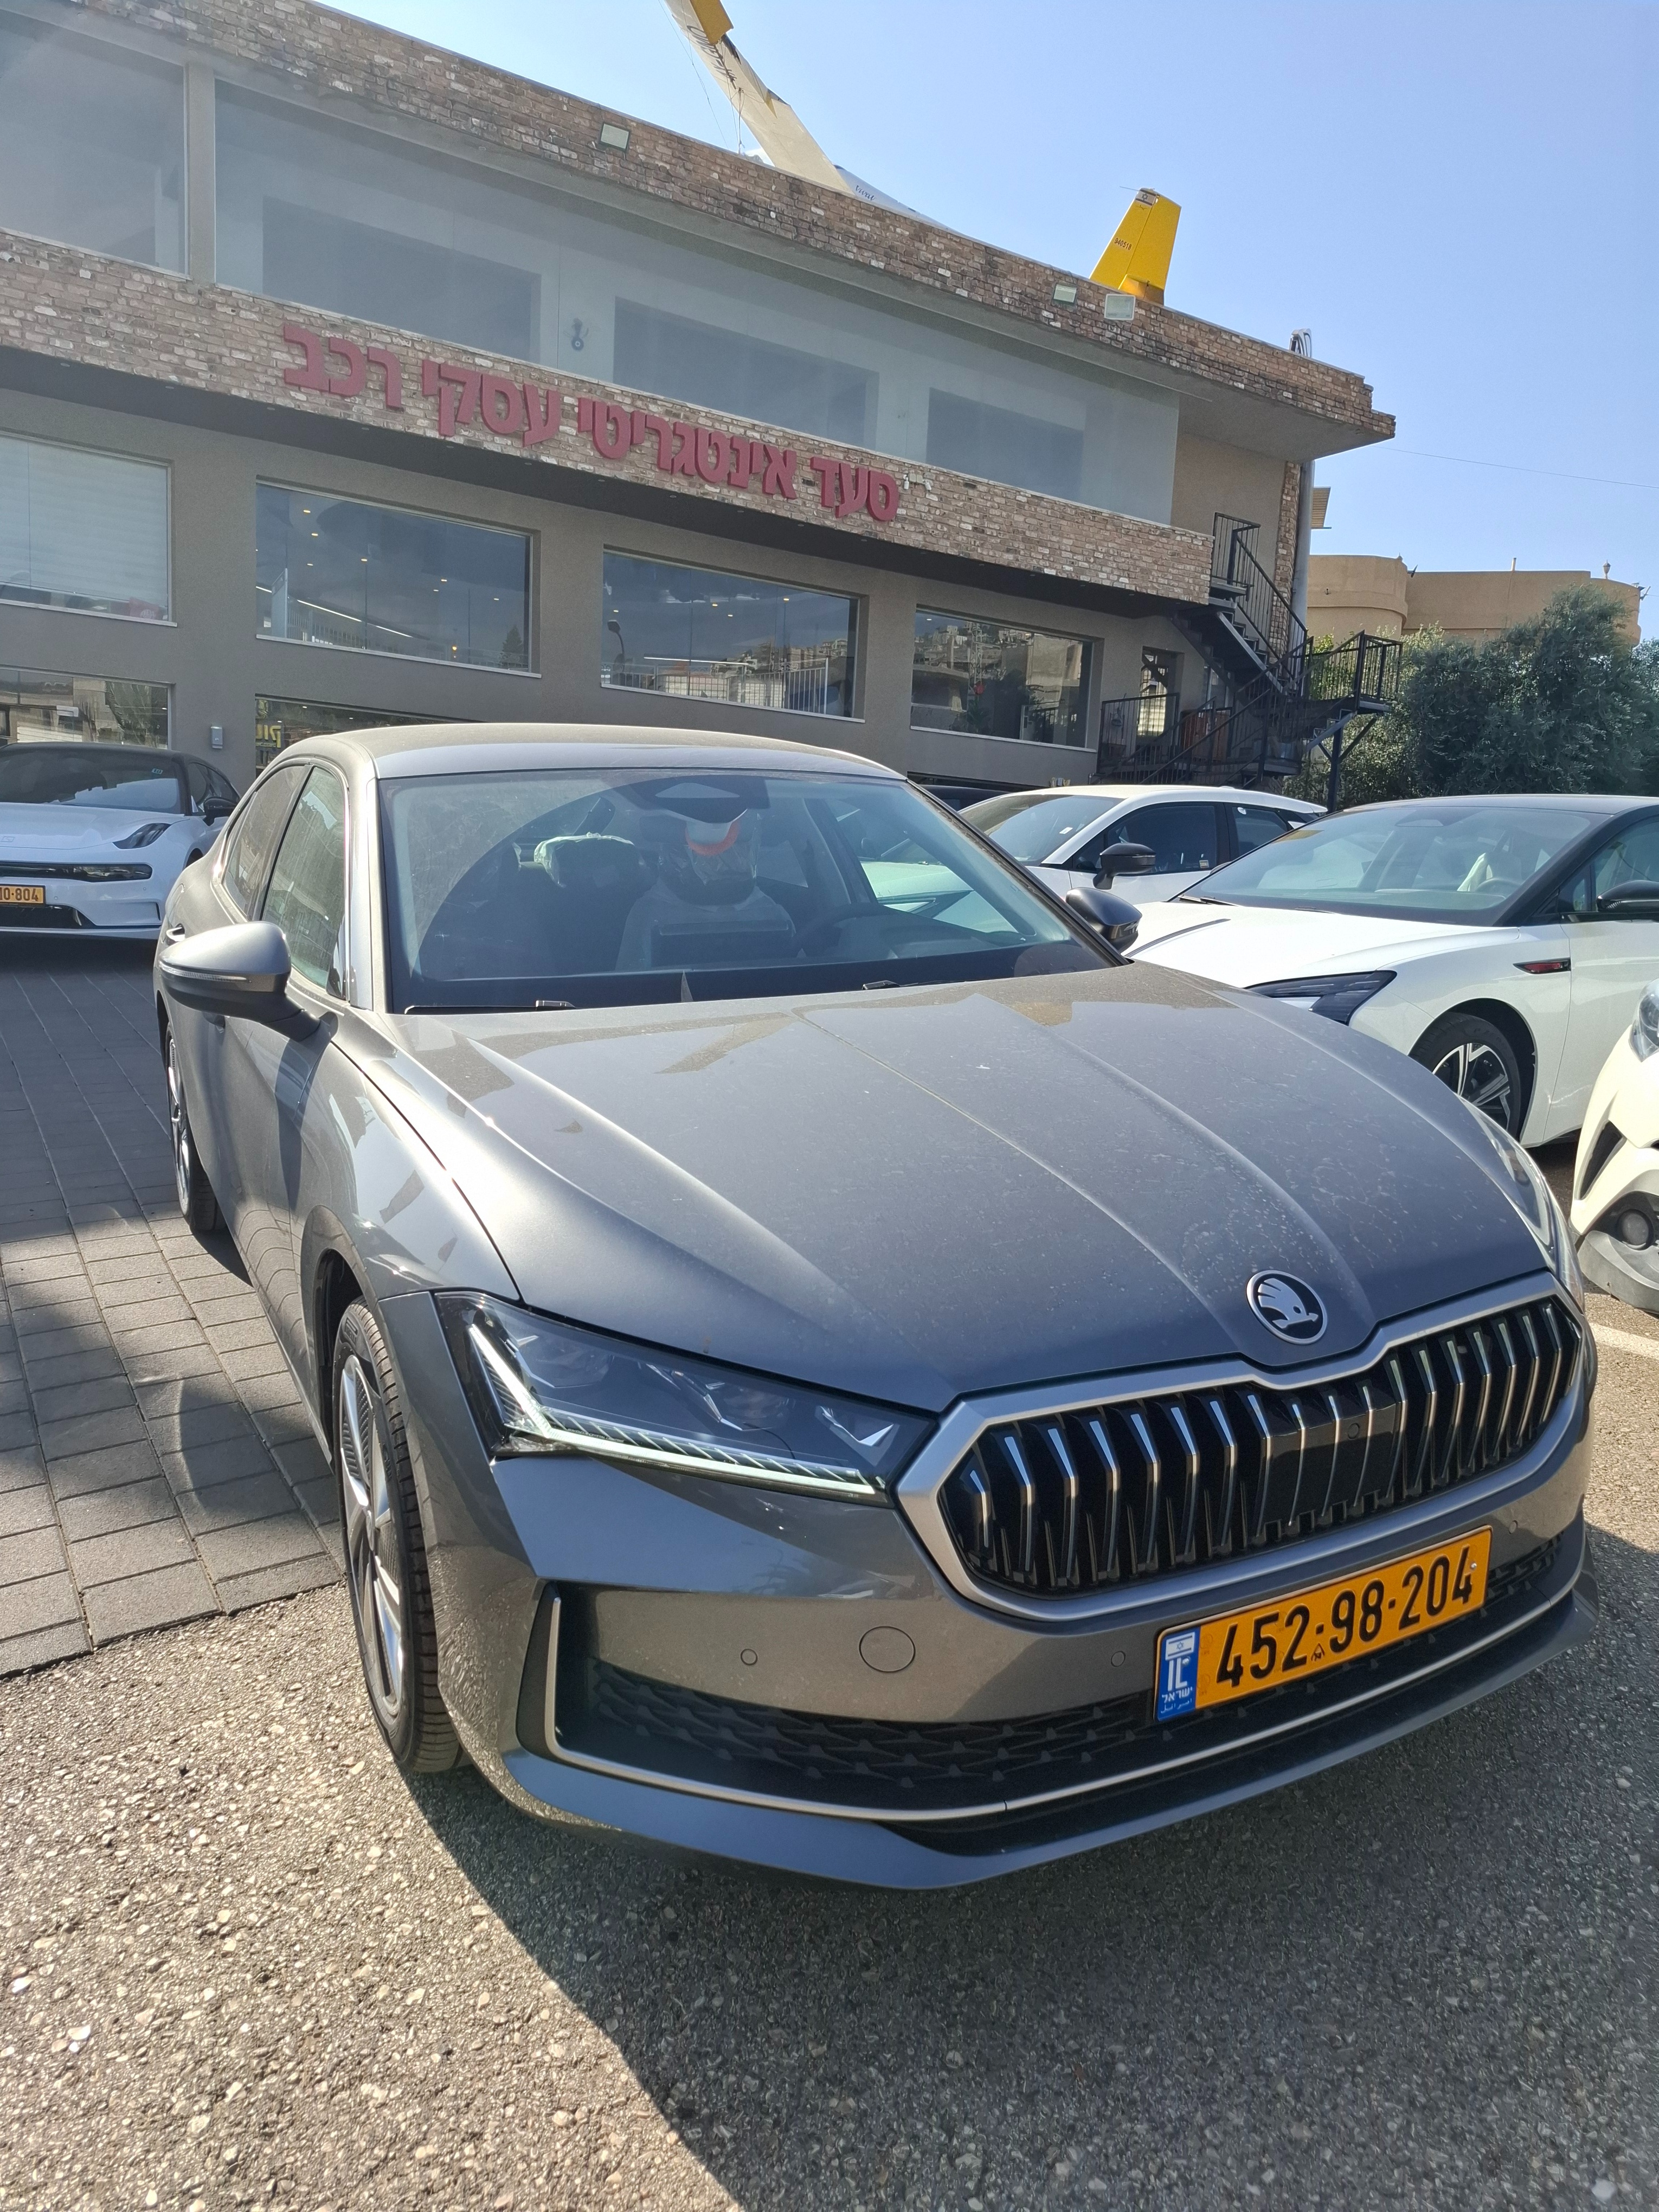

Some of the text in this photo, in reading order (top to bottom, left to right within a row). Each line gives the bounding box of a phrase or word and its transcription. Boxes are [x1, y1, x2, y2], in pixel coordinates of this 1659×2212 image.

[1114, 237, 1131, 250] 940518
[284, 325, 899, 522] סעד אינטגריטי עסקי רכב
[1168, 1657, 1187, 1692] IL
[1162, 1687, 1193, 1703] ישראל
